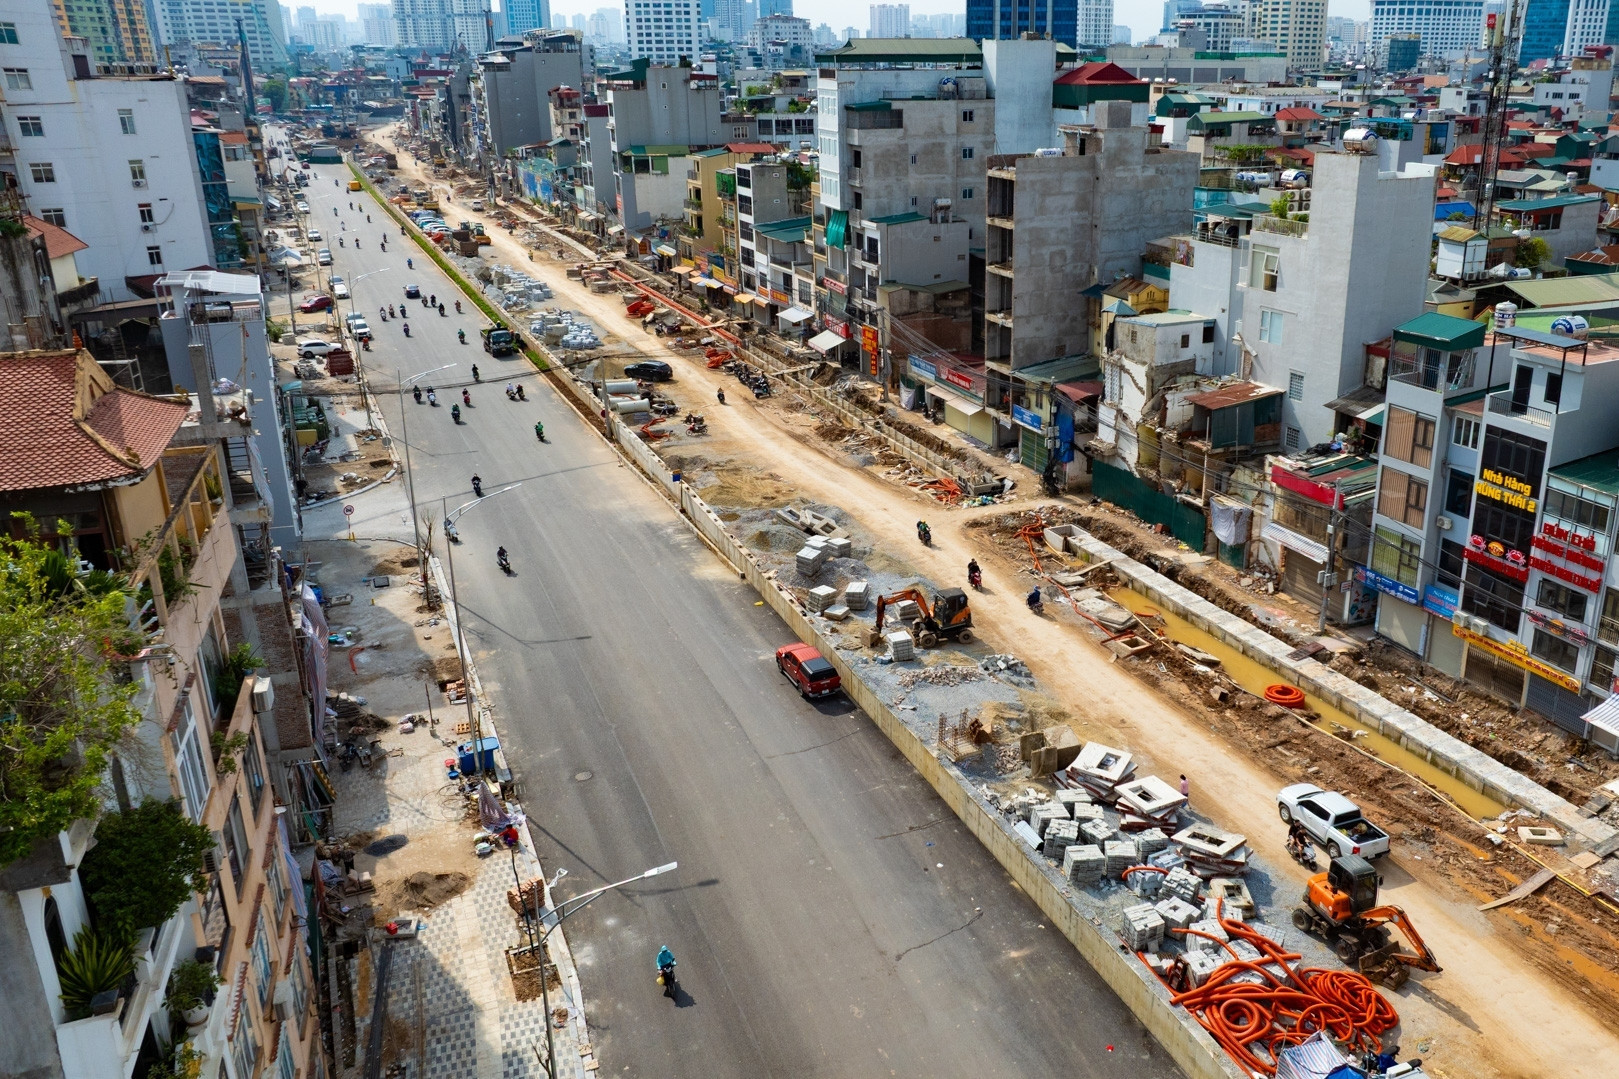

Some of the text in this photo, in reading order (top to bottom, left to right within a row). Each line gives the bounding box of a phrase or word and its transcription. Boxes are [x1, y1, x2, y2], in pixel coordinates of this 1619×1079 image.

[1483, 469, 1532, 496] Nhà Hàng
[1475, 482, 1536, 513] HÙNG THÁI 2
[1543, 523, 1569, 542] BÚN
